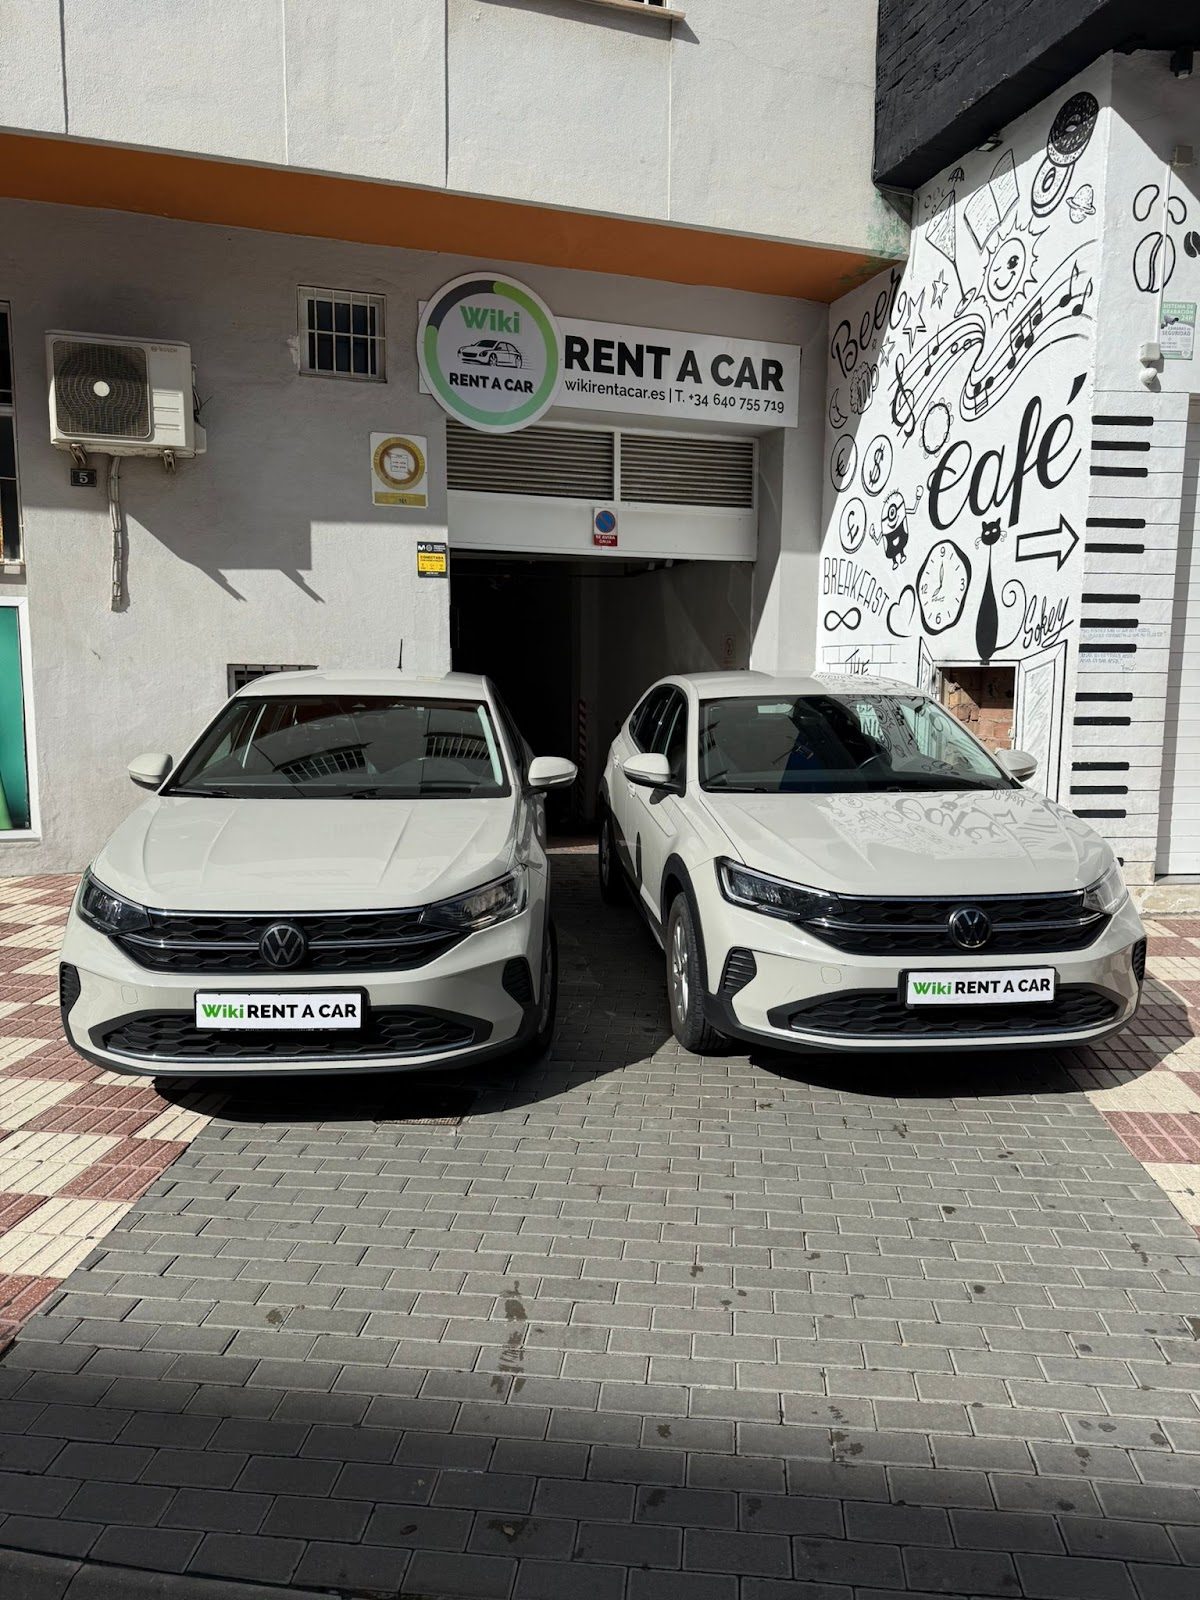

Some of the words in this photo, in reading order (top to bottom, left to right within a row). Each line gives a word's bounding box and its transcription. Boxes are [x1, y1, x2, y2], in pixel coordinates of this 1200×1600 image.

[460, 305, 520, 334] Wiki
[831, 268, 907, 379] Beer
[564, 335, 671, 379] RENT
[676, 350, 703, 384] A
[710, 353, 784, 392] CAR
[449, 372, 489, 389] RENT
[491, 377, 501, 390] A
[504, 379, 534, 394] CAR
[565, 378, 665, 401] wikirentacar.es
[675, 389, 685, 403] T.
[688, 393, 708, 407] +34
[713, 393, 736, 408] 640
[739, 397, 760, 412] 755
[763, 399, 785, 414] 719
[926, 372, 1088, 531] Café
[79, 472, 89, 484] 5
[823, 556, 890, 617] BREAKFAST
[912, 981, 952, 995] Wiki
[954, 980, 1001, 994] RENT
[1003, 980, 1014, 993] A
[1018, 978, 1051, 992] CAR
[201, 1004, 244, 1019] Wiki
[247, 1004, 298, 1019] RENT
[301, 1004, 315, 1018] A
[318, 1004, 357, 1018] CAR
